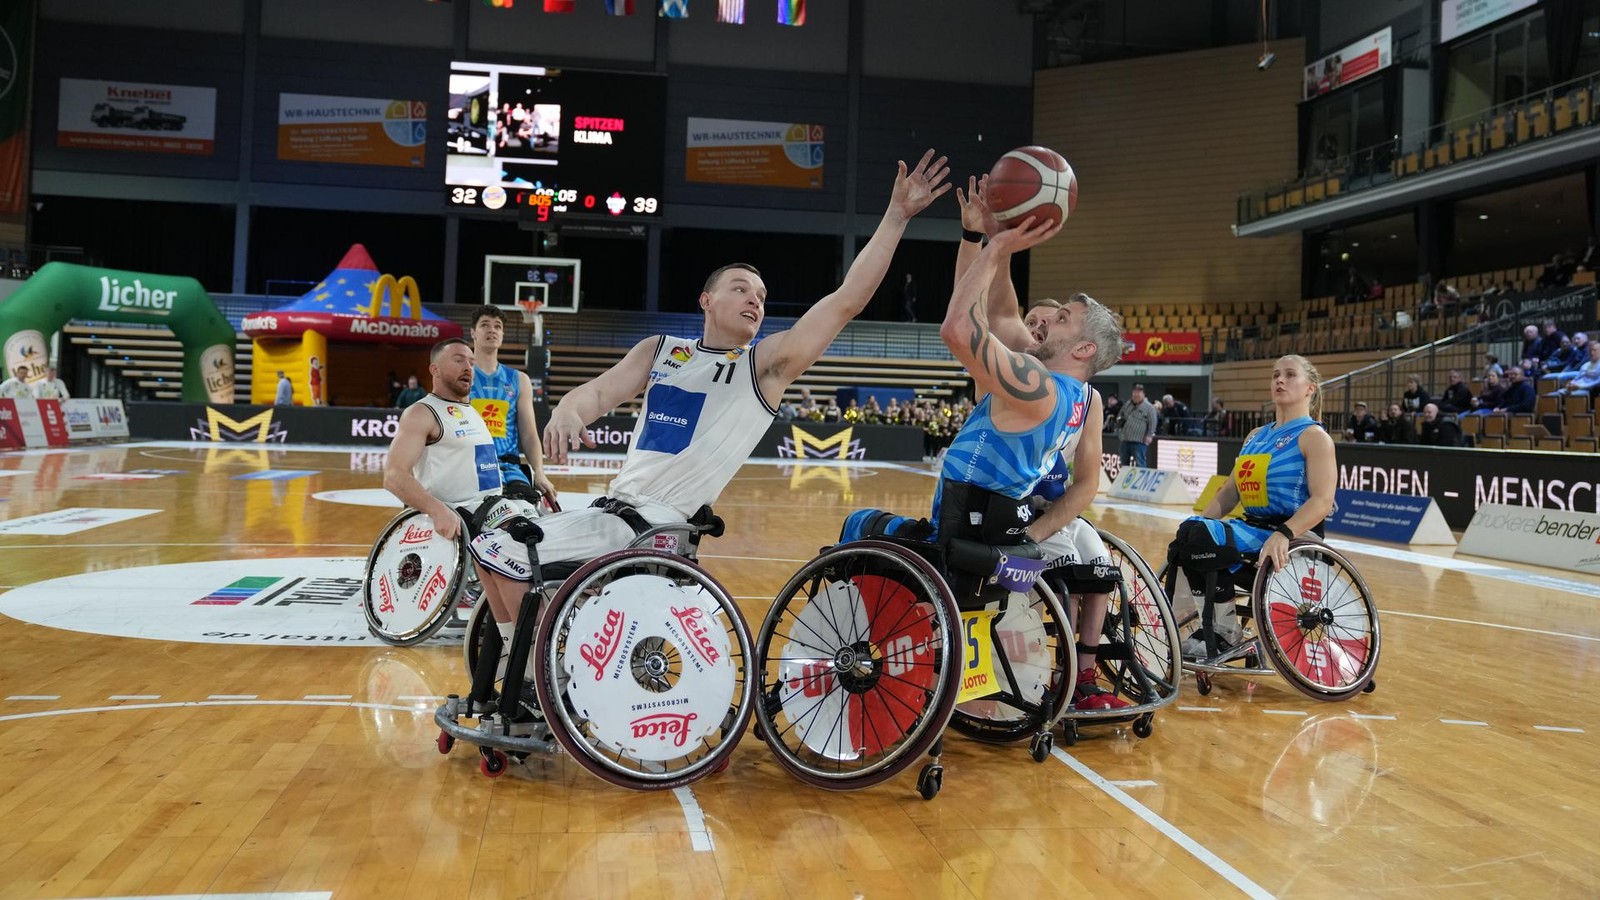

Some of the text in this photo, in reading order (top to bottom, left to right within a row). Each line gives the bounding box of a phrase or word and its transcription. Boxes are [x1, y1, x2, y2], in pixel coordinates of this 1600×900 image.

[108, 86, 172, 100] Knebel
[284, 107, 381, 118] WR-HAUSTECHNIK
[574, 116, 624, 131] SPITZEN
[573, 130, 613, 144] KLIMA
[692, 131, 782, 141] WR-HAUSTECHNIK
[451, 188, 477, 204] 32
[632, 197, 658, 214] 39
[97, 276, 178, 311] Licher
[350, 319, 439, 338] McDonald's
[96, 406, 122, 424] LANG
[1131, 470, 1165, 492] ZME
[1238, 481, 1260, 492] LOTTO
[1340, 464, 1428, 498] MEDIEN
[484, 503, 510, 523] RITTAL
[399, 524, 434, 545] Leica
[504, 558, 526, 576] JAKO
[378, 573, 394, 613] Leica
[418, 565, 447, 612] Leica
[580, 608, 625, 681] Leica
[670, 606, 721, 667] Leica
[613, 620, 639, 680] MICROSYSTEMS
[665, 621, 704, 673] MICROSYSTEMS
[964, 673, 987, 689] LOTTO
[631, 698, 689, 711] MICROSYSTEMS
[629, 713, 698, 748] Leica
